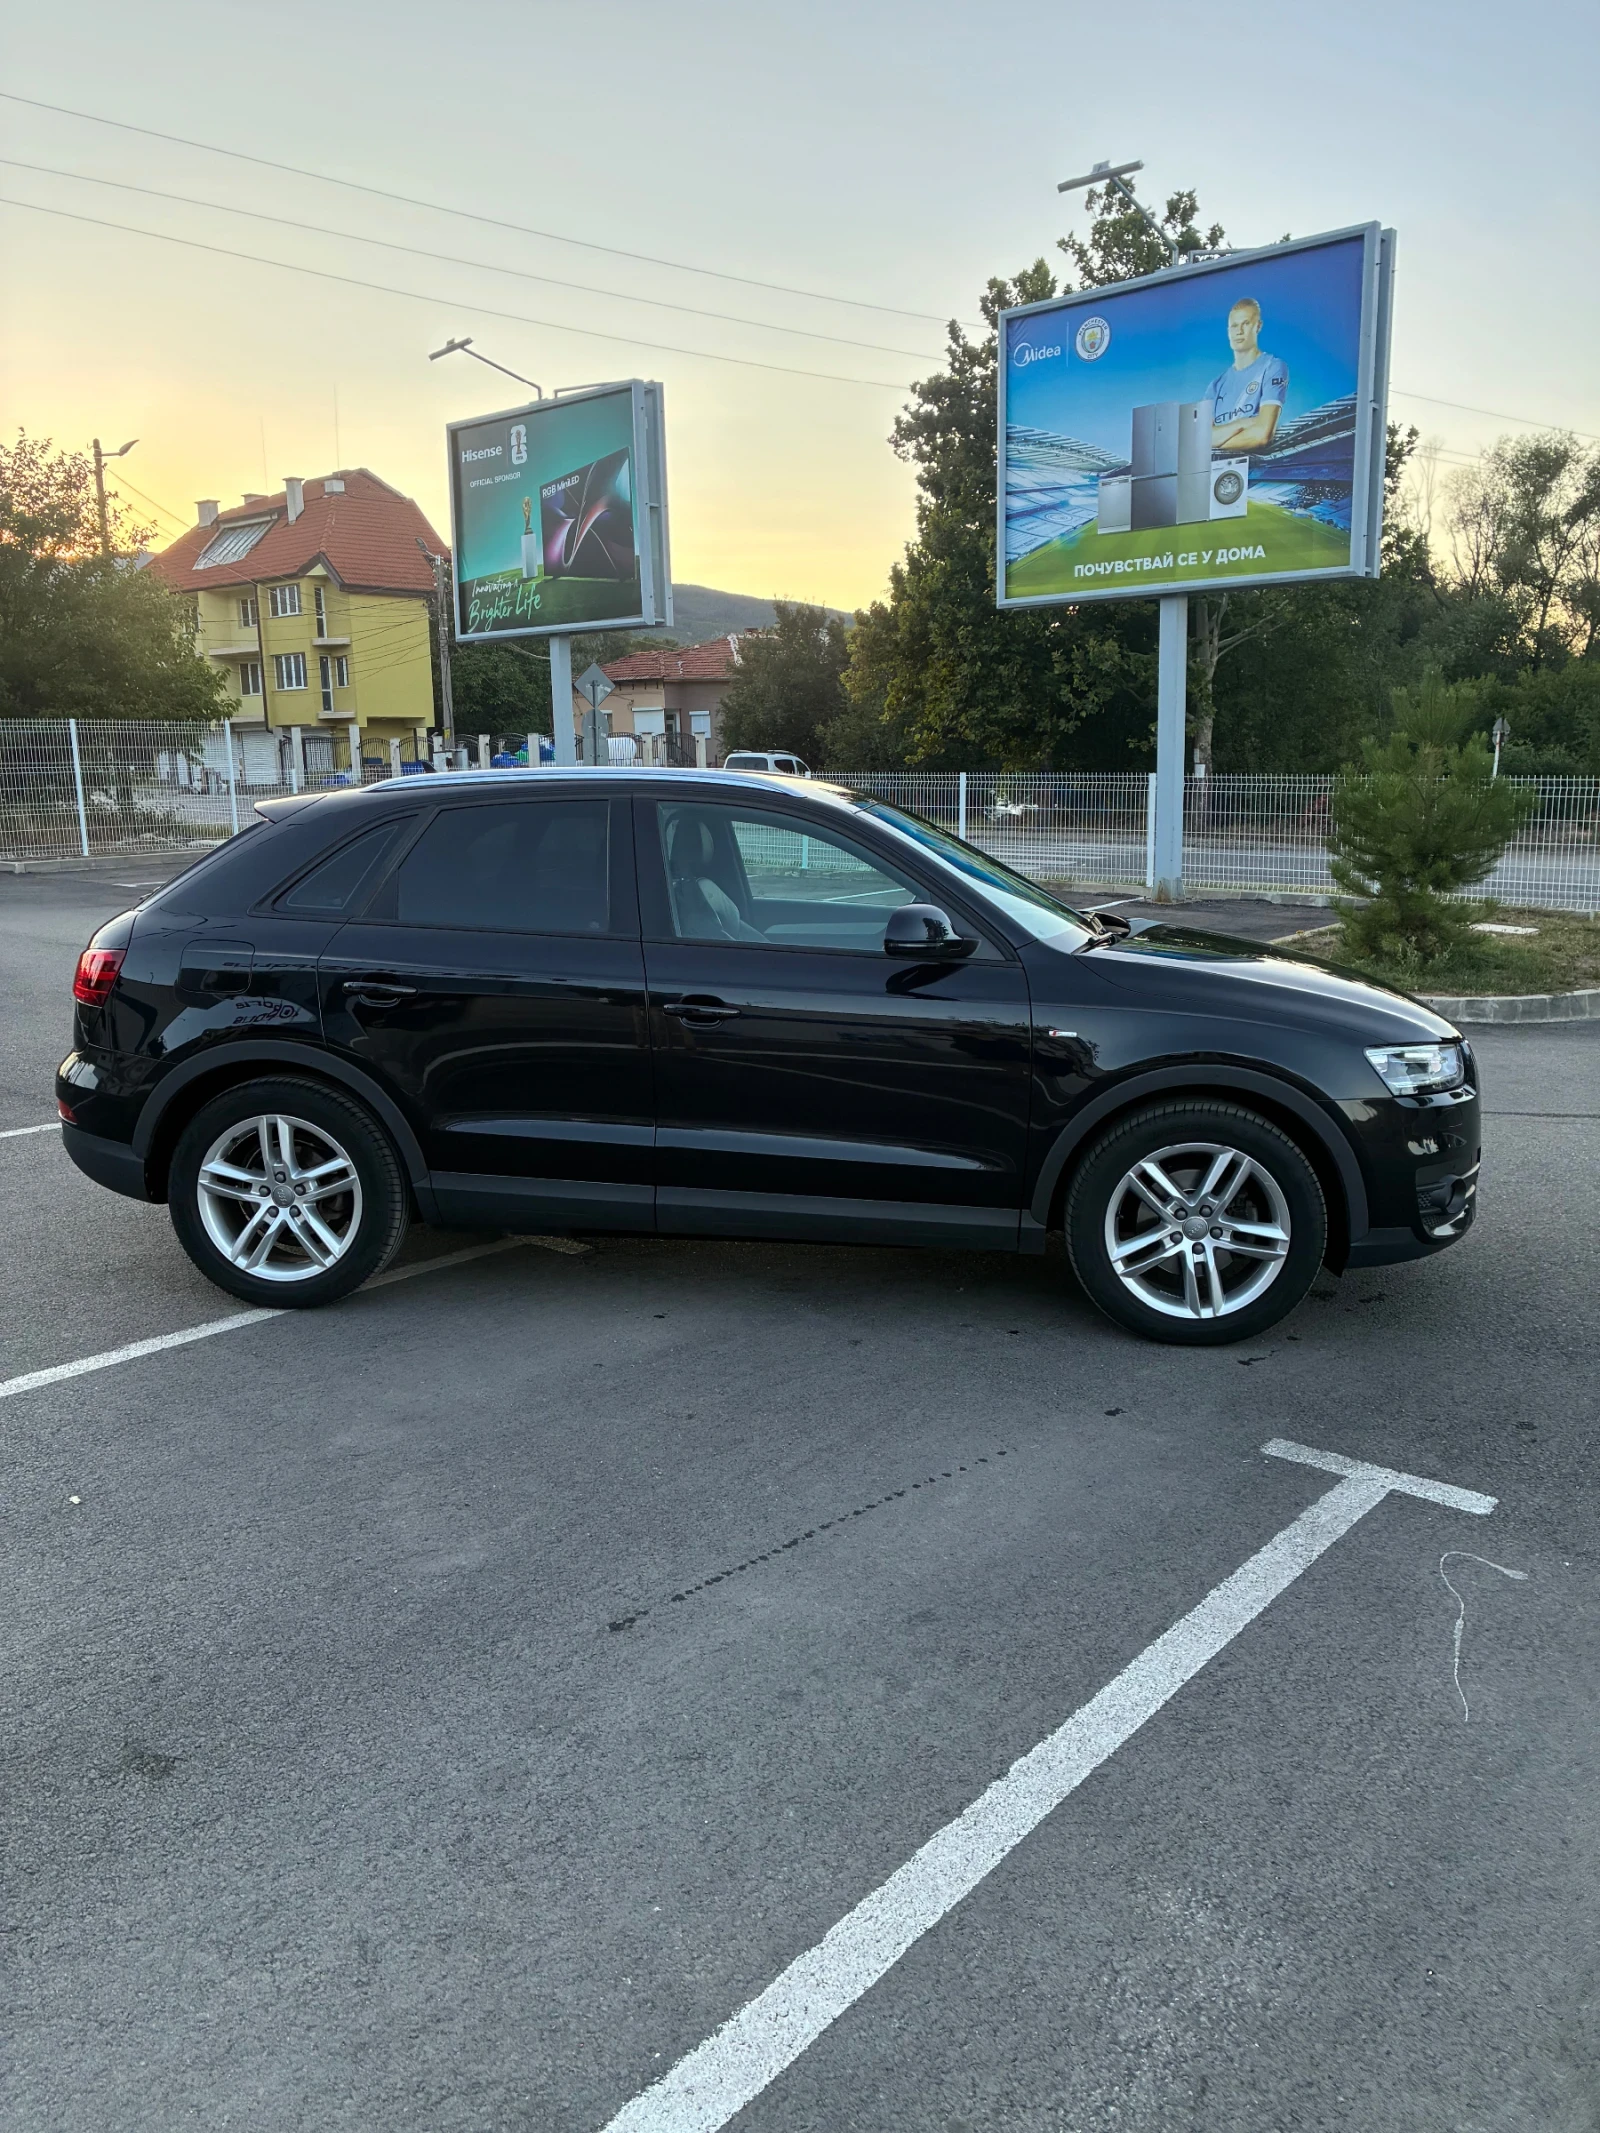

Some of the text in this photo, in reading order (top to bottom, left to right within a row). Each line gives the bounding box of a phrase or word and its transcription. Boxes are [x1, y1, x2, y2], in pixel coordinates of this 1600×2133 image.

[1013, 342, 1061, 367] Midea
[1214, 403, 1254, 424] ETIHAD
[461, 445, 503, 463] Hisense
[469, 471, 521, 488] OFFICIAL SPONSOR
[542, 475, 580, 498] RGB MiniLED
[1074, 545, 1266, 578] ПОЧУВСТВАЙ СЕ У ДОМА
[472, 575, 512, 597] Innovating
[467, 582, 542, 633] Brighter Life
